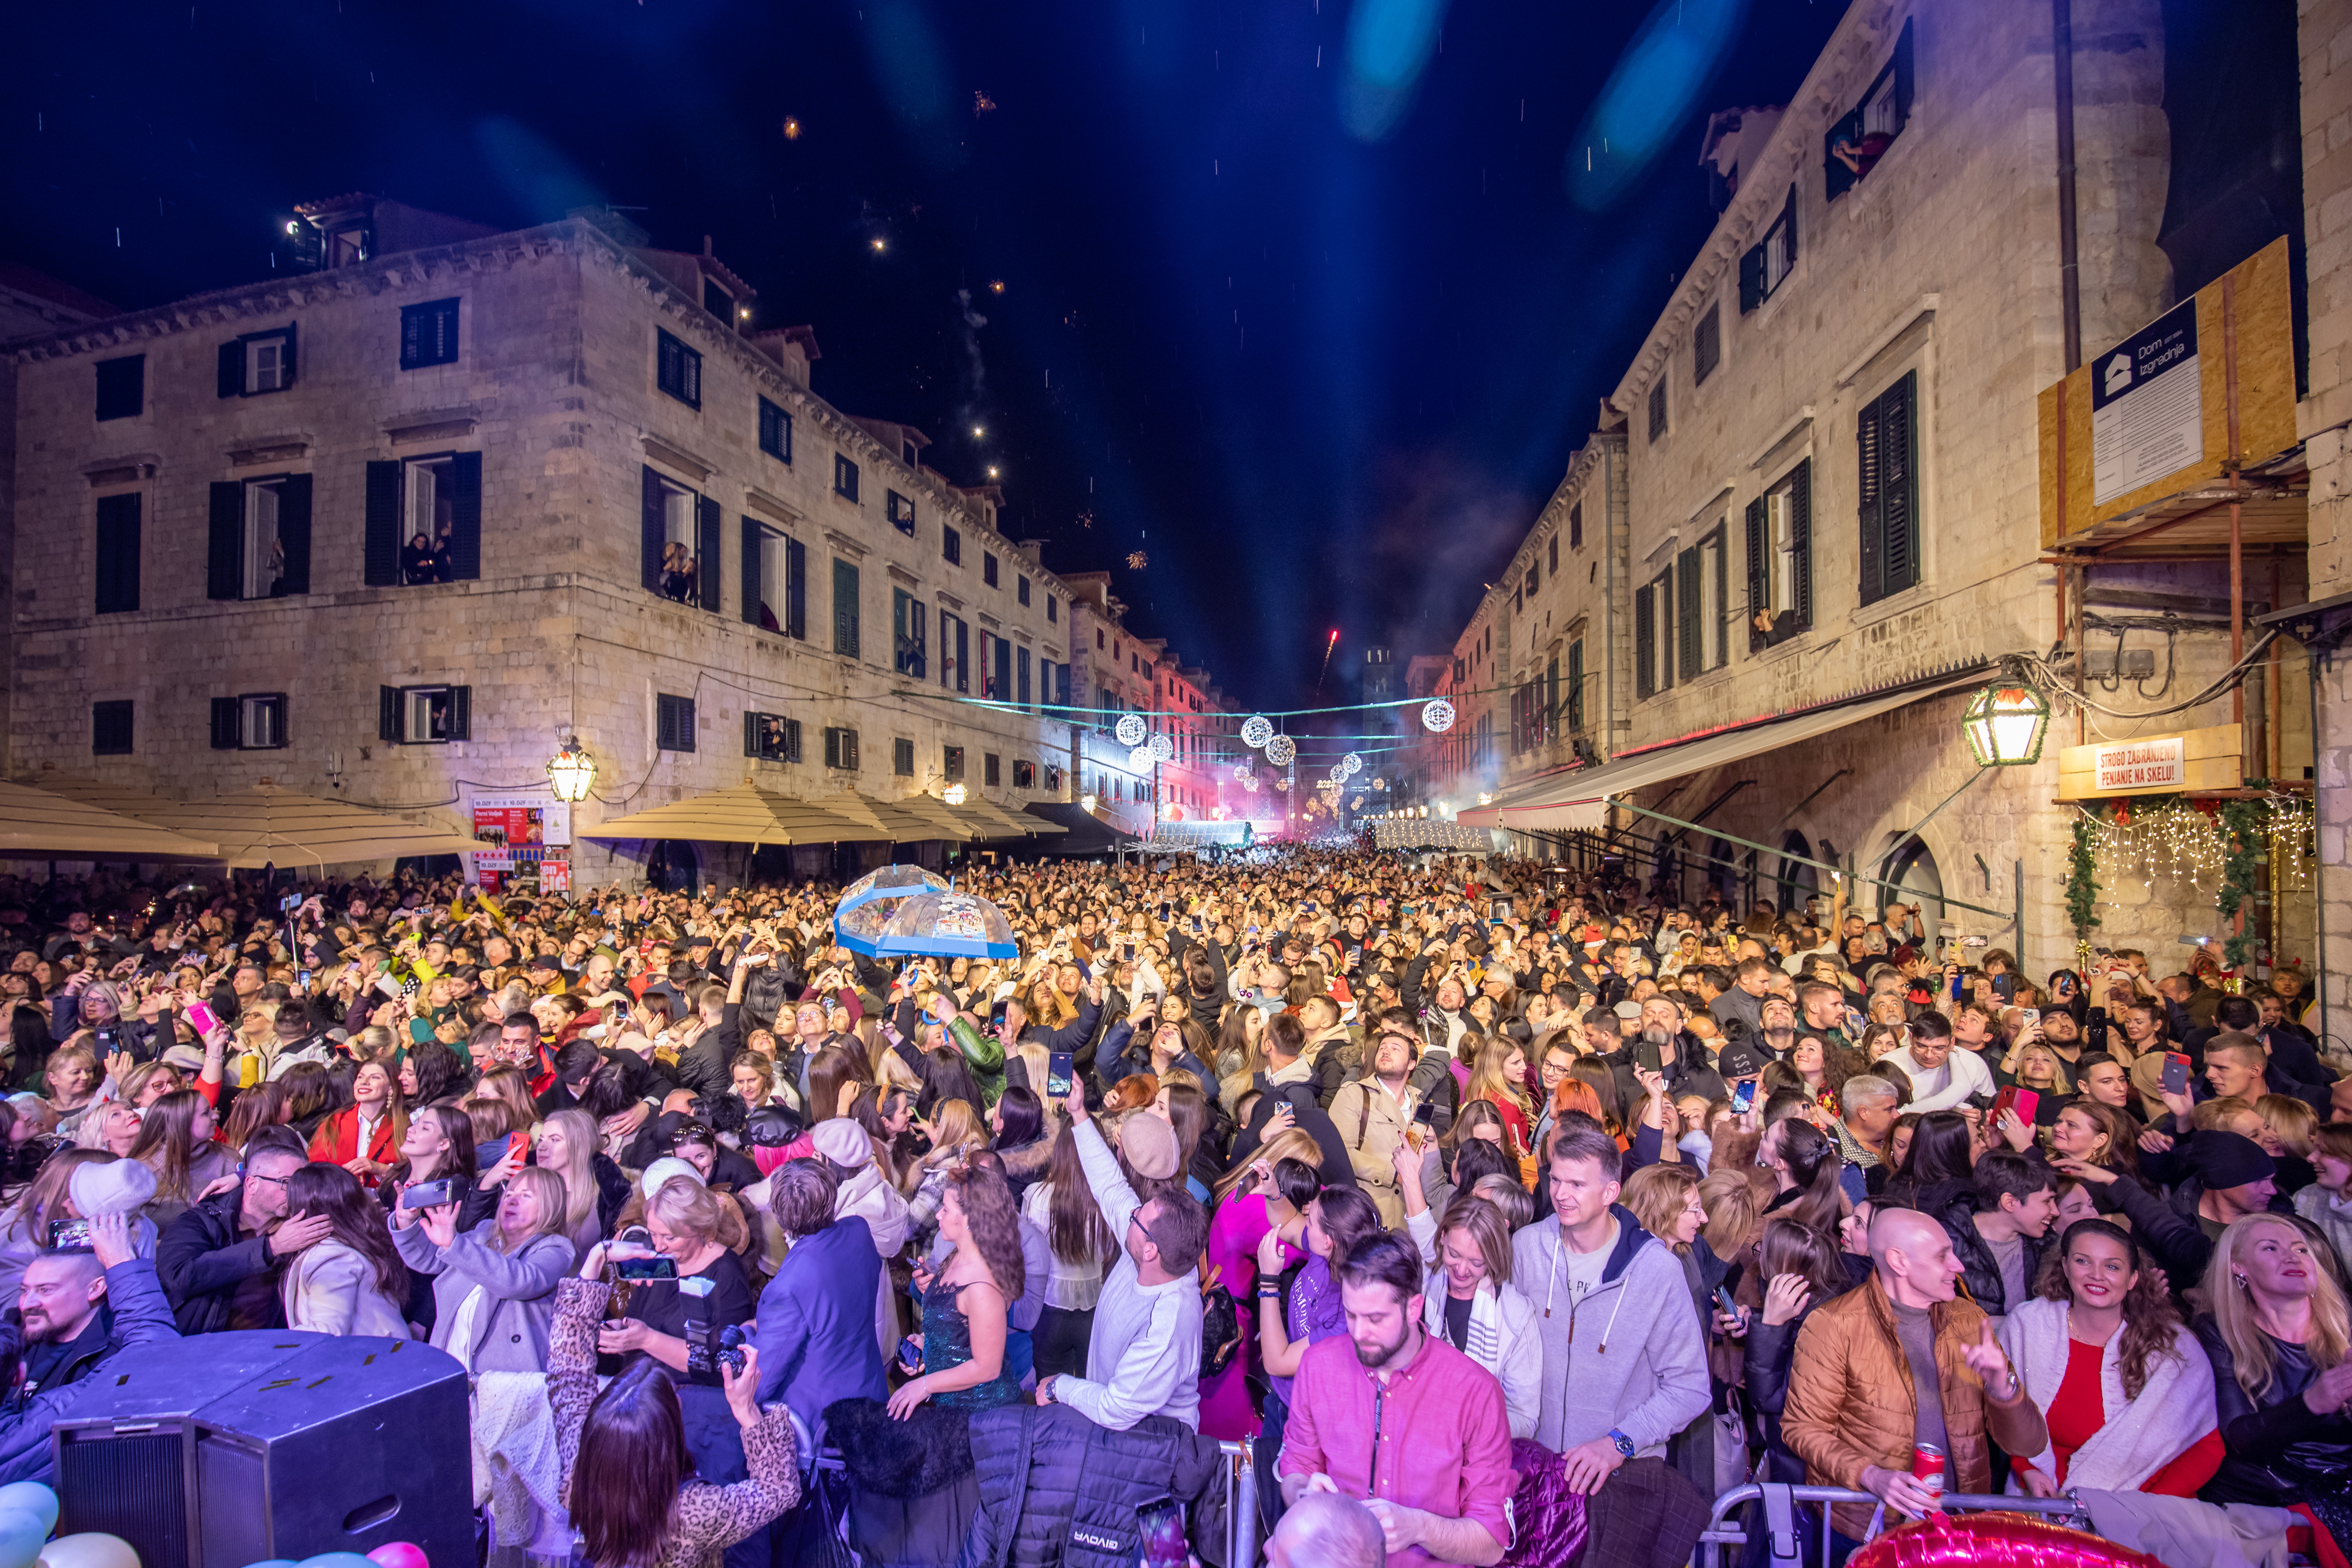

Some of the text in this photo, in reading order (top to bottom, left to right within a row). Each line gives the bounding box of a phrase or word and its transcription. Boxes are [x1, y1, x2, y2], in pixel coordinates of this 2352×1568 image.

[2139, 339, 2162, 360] Dom
[2140, 343, 2184, 376] Izgradnja
[2101, 745, 2176, 768] STROGO ZABRANJENO
[2102, 765, 2174, 786] PENJANJE NA SKELU!
[1074, 1530, 1118, 1550] GIVOVA
